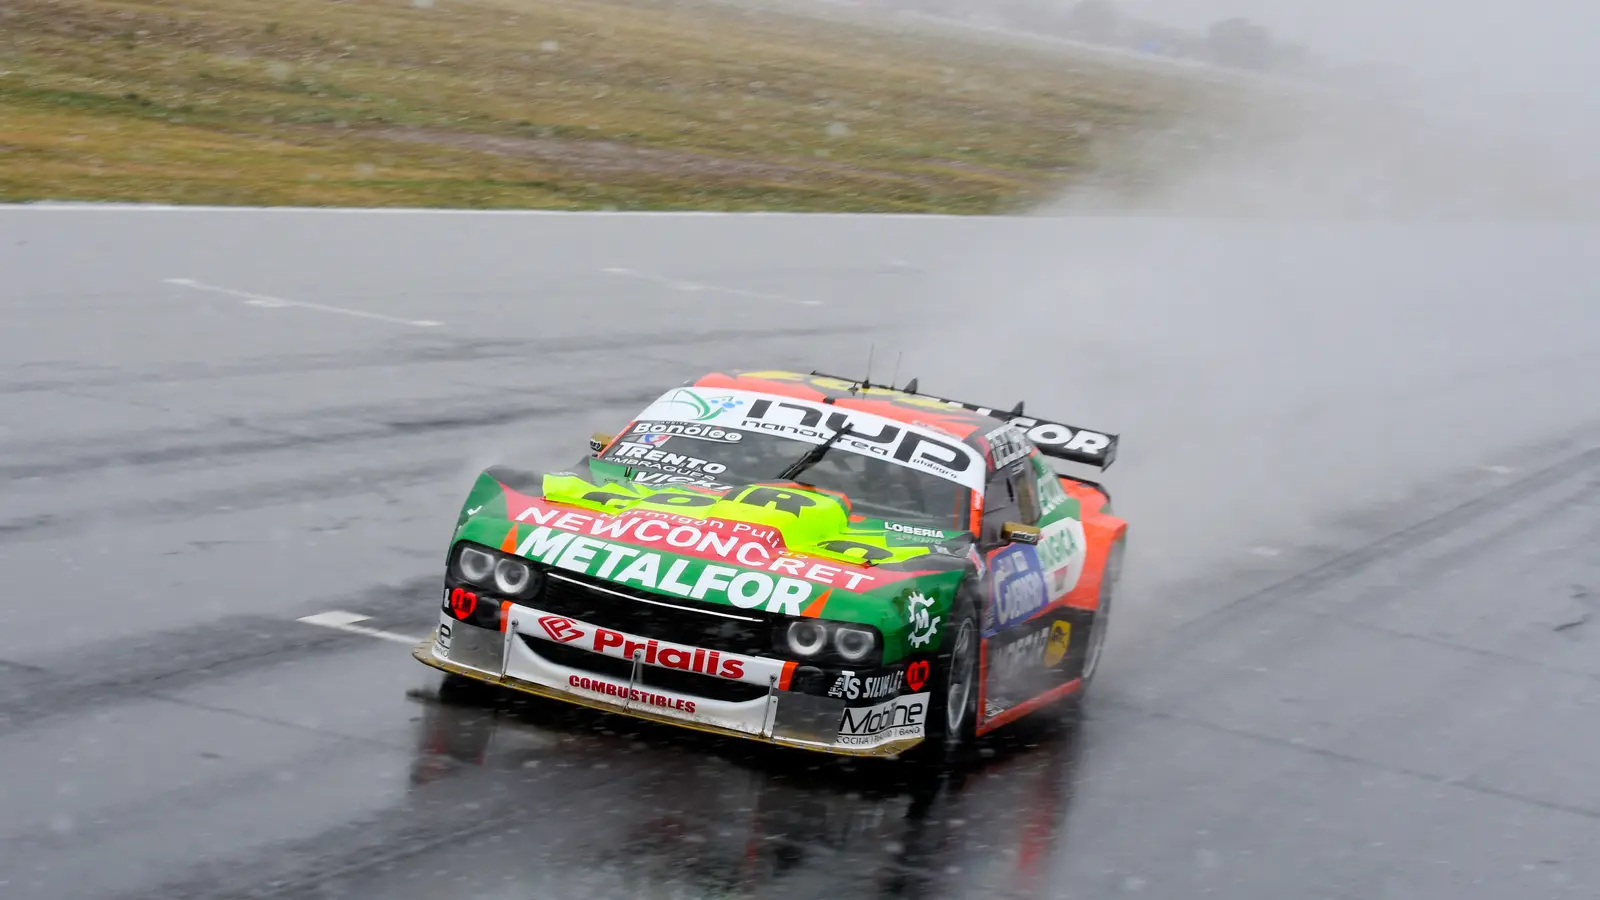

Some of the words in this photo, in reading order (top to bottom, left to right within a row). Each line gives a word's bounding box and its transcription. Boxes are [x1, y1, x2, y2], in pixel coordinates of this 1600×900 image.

[614, 441, 728, 475] TRENTO
[515, 506, 876, 591] NEWCONCRET
[884, 521, 945, 538] LOBERIA
[515, 525, 813, 616] METALFOR
[592, 627, 745, 680] Prialis
[568, 674, 696, 714] COMBUSTIBLES
